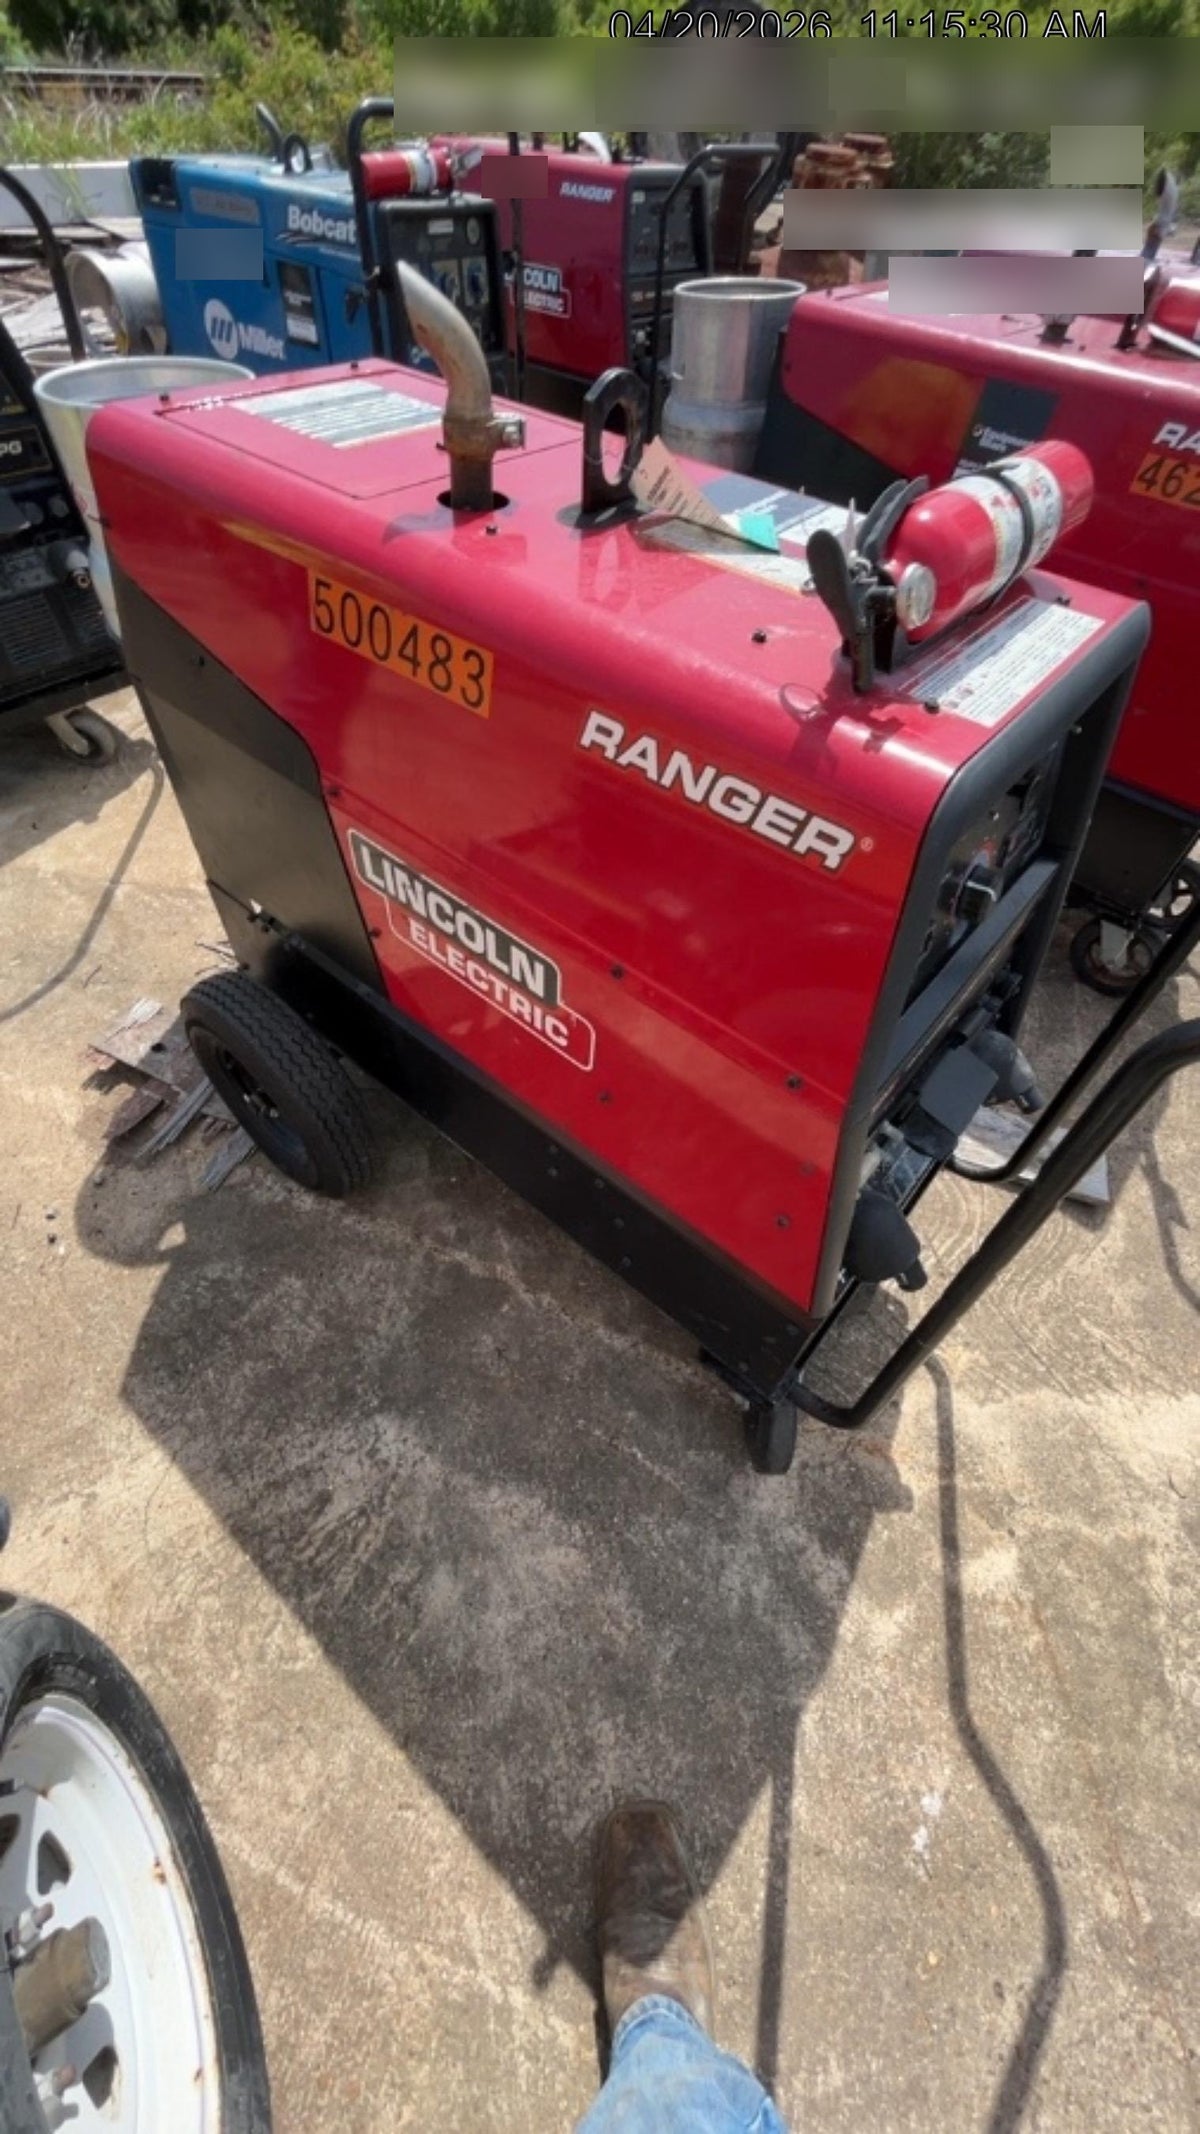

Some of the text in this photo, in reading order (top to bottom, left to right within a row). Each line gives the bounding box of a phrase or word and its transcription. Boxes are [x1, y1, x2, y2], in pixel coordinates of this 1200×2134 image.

[287, 204, 355, 245] Bobcat
[559, 182, 614, 202] RANGER
[314, 577, 484, 709] 500483
[360, 843, 544, 999] LINCOLN
[408, 916, 569, 1047] ELECTRIC
